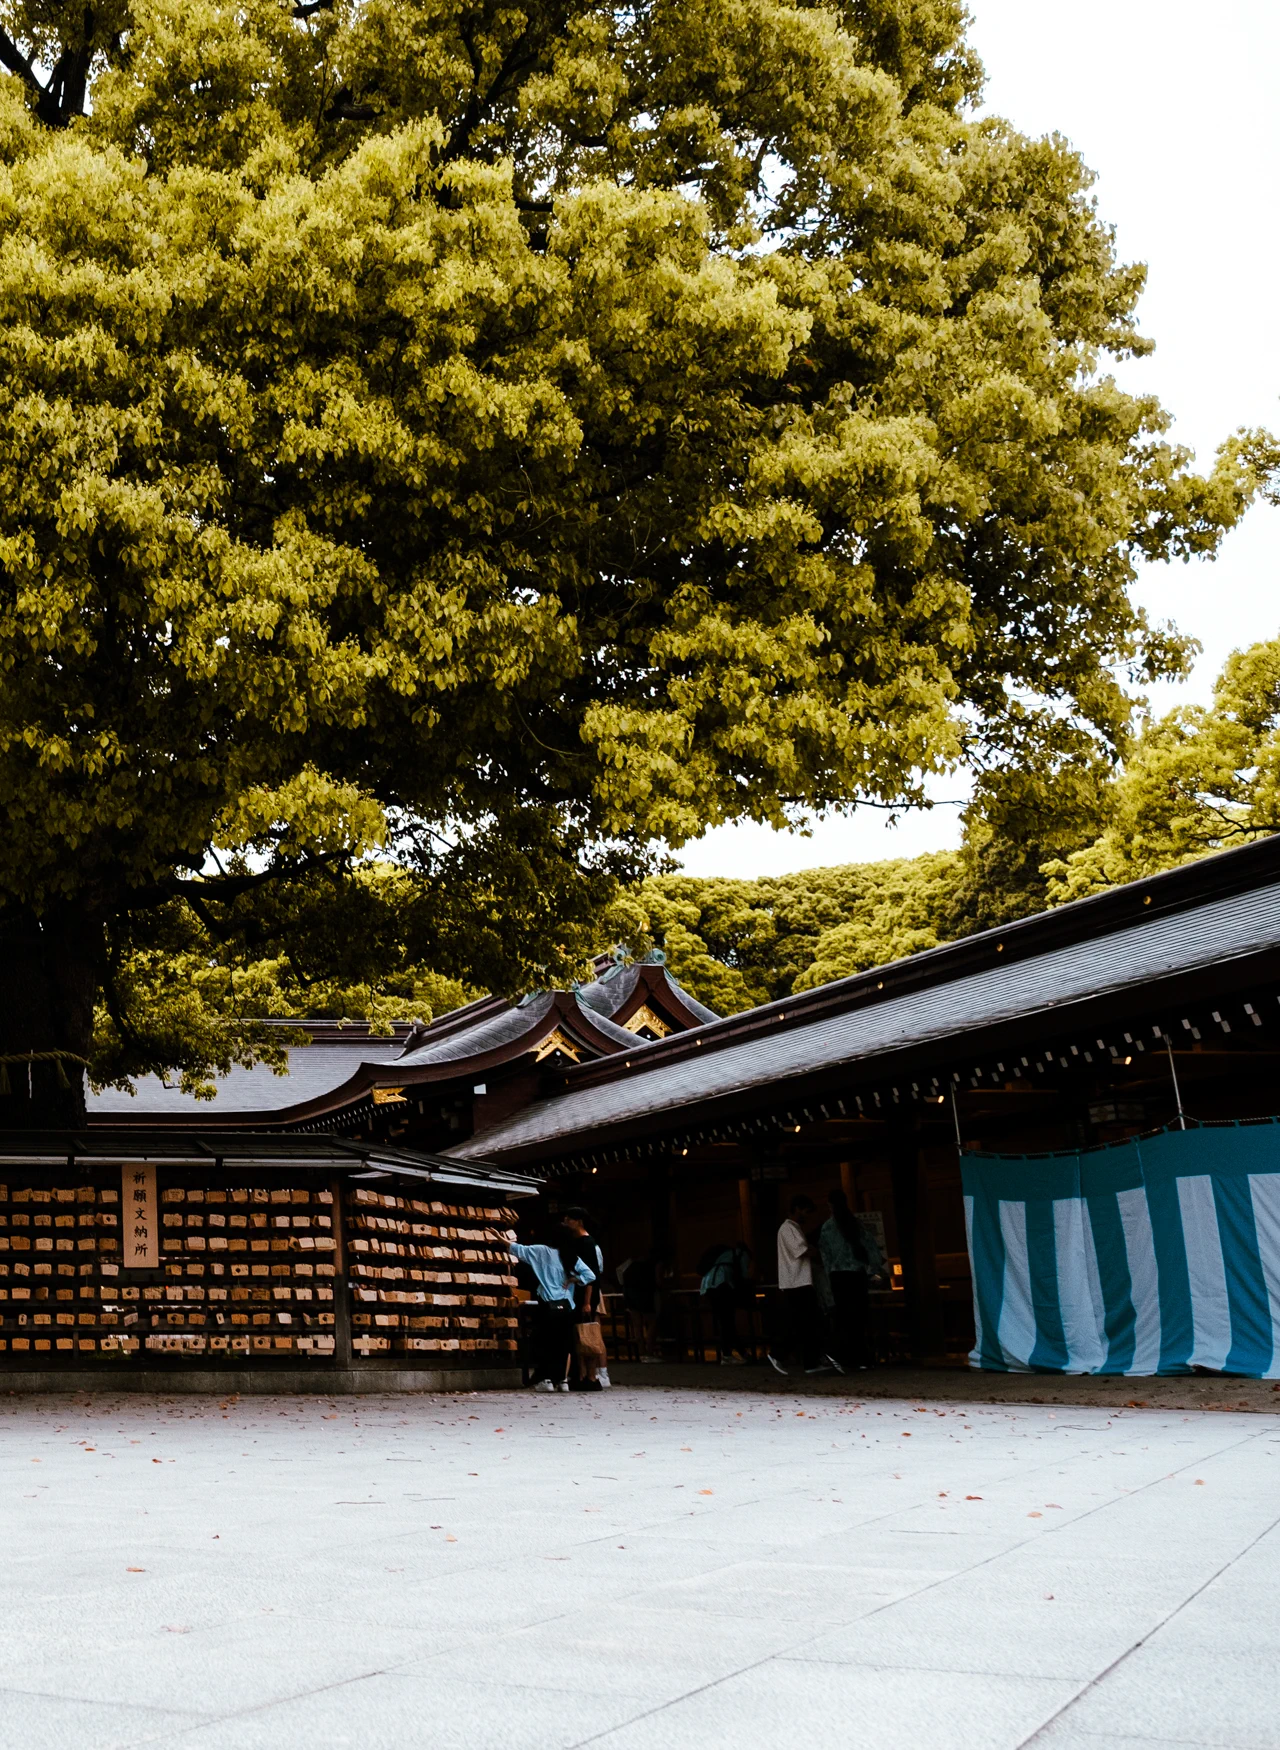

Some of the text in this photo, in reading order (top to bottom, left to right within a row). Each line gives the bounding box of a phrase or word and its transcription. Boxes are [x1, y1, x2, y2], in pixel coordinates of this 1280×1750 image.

[133, 1171, 148, 1257] 祈願文納所
